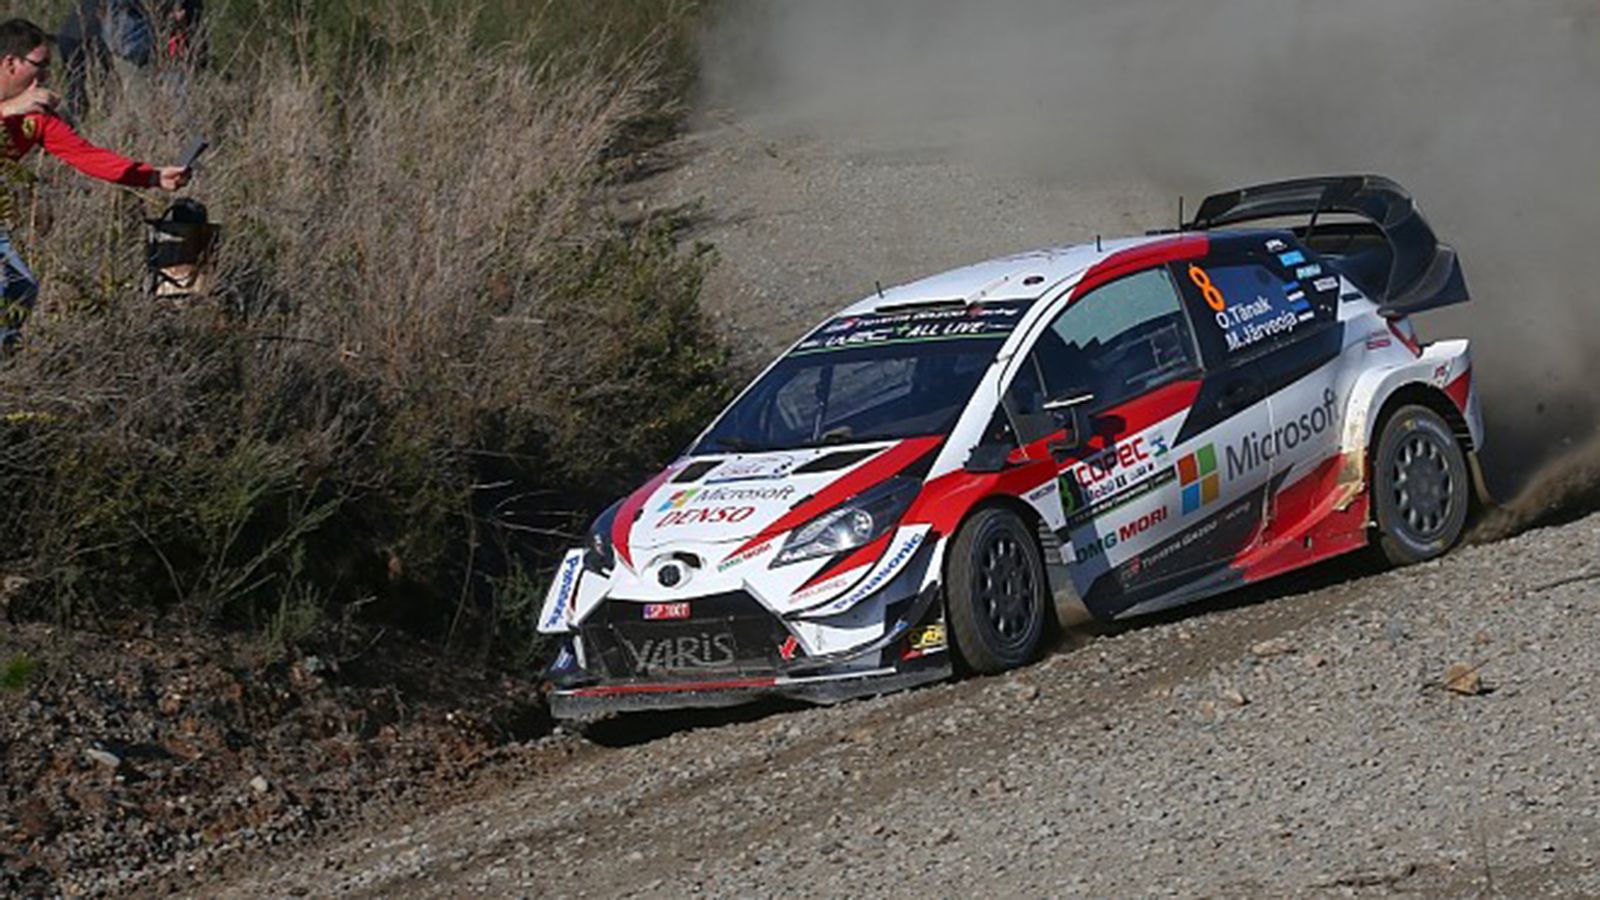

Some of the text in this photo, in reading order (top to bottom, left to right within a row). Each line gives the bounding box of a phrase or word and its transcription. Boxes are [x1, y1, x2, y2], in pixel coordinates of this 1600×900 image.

[1188, 266, 1225, 312] 8
[1226, 387, 1340, 481] Microsoft
[655, 506, 755, 528] DENSO
[694, 485, 796, 502] Microsoft
[1076, 532, 1117, 563] DMG
[1119, 505, 1168, 542] MORI
[833, 532, 924, 610] Panasonic
